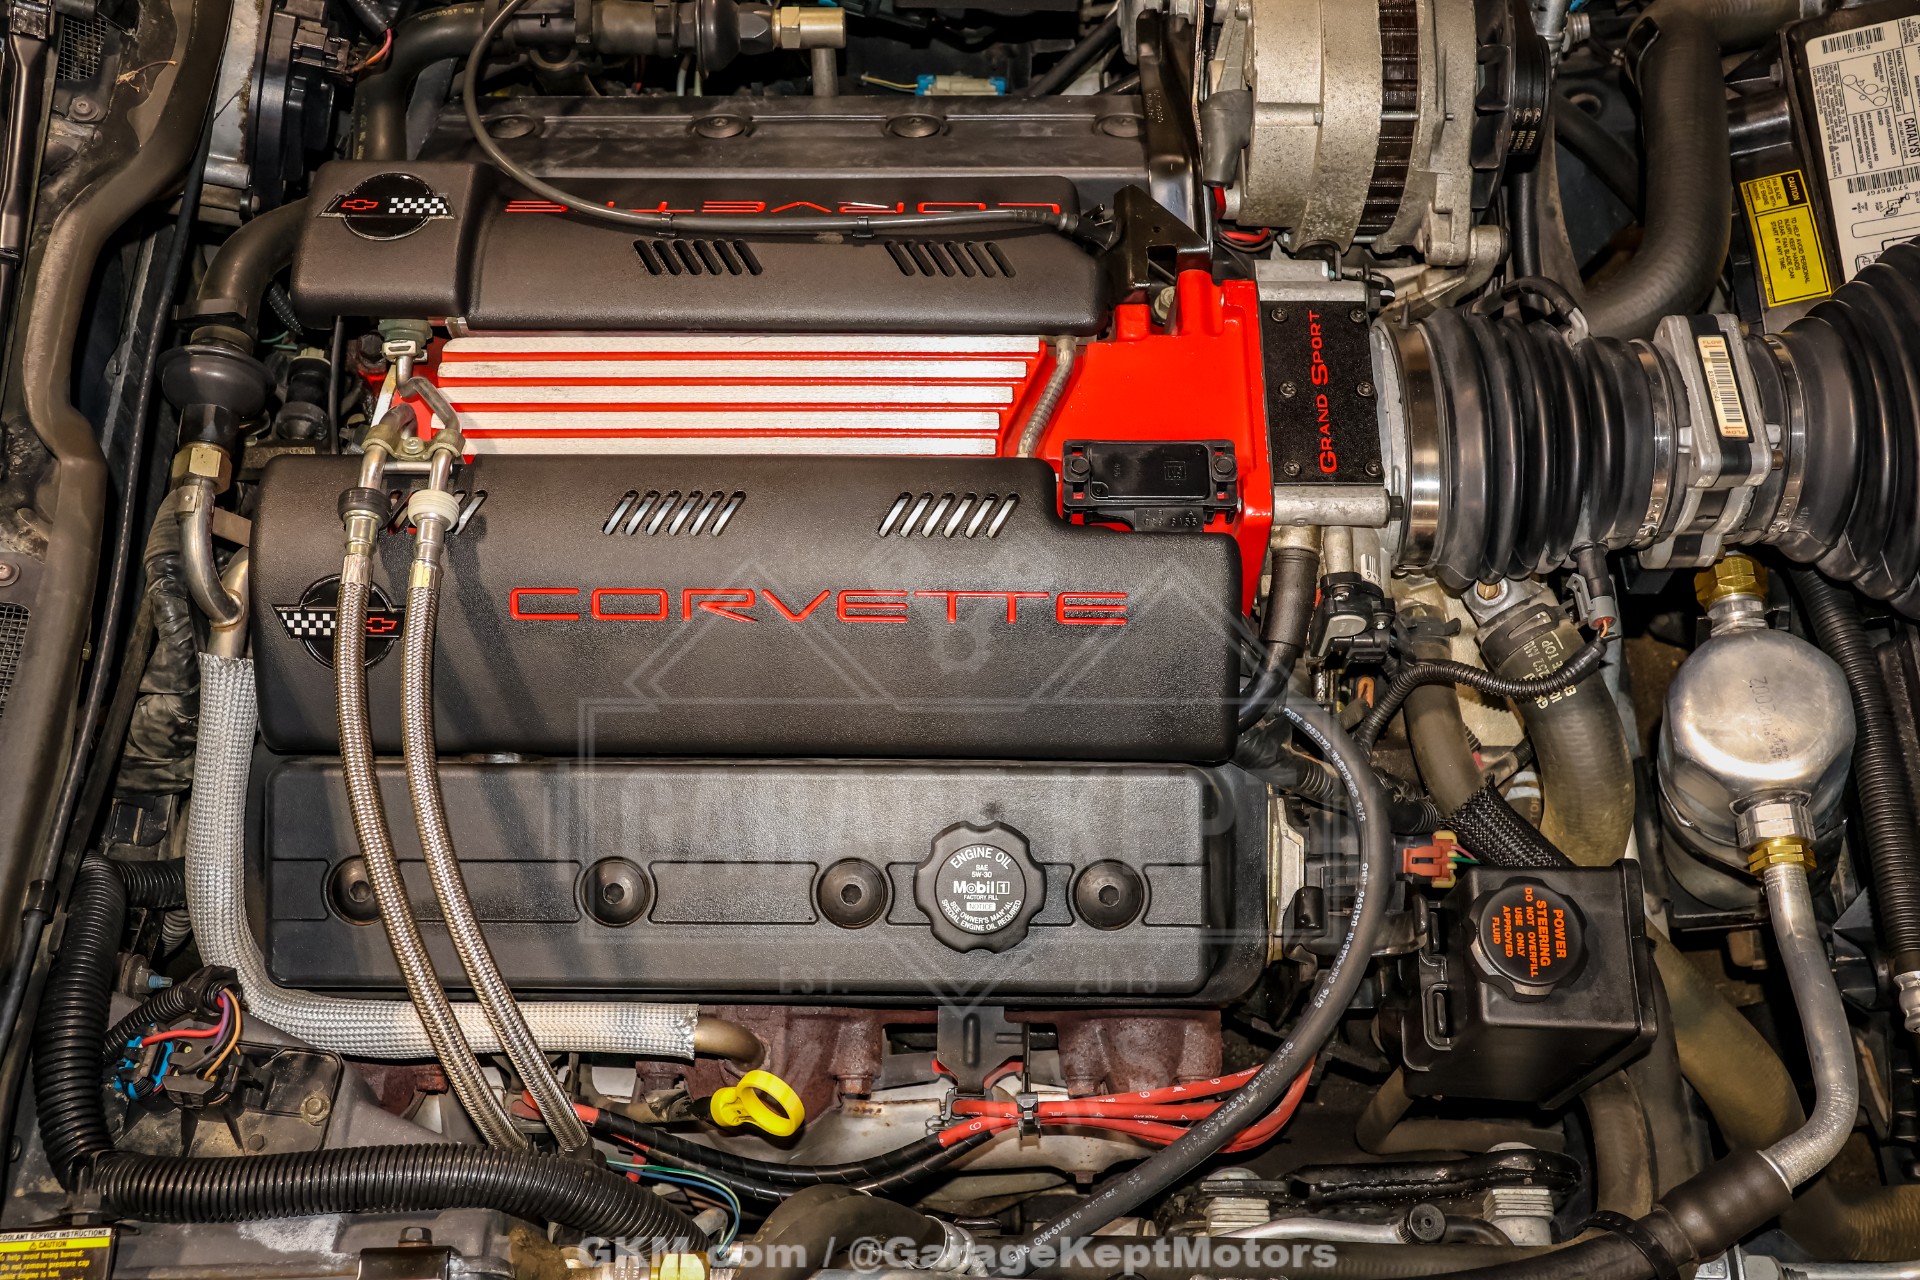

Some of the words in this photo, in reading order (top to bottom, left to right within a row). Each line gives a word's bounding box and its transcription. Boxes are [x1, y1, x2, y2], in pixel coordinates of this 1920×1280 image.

[1895, 49, 1903, 66] MANUAL
[1898, 66, 1908, 96] TRANSMISSION
[1852, 115, 1860, 137] ADDITIONAL
[1858, 113, 1867, 139] MAINTENANCE
[1863, 140, 1871, 160] SCHEDULE
[1887, 128, 1896, 155] ADJUSTMENTS
[1903, 117, 1920, 158] CATALYST
[1760, 189, 1769, 205] ENGINE
[1764, 179, 1773, 194] STARTS
[1773, 186, 1782, 200] BLADE
[1787, 175, 1799, 200] CAUTION
[1770, 220, 1778, 236] START
[1792, 224, 1800, 237] HELP
[1788, 237, 1796, 251] KEEP
[1795, 237, 1804, 254] AVOID
[1783, 248, 1792, 266] BLADE
[1791, 252, 1800, 270] HANDS
[1787, 266, 1795, 279] CAN
[1799, 255, 1811, 284] PERSONAL
[508, 587, 1128, 626] CORVETTE
[1540, 637, 1559, 661] TOP
[950, 847, 993, 869] ENGINE
[996, 852, 1013, 869] OIL
[953, 881, 994, 893] Mobil
[1525, 887, 1533, 902] DO
[942, 899, 959, 923] SPECIAL
[960, 921, 984, 931] ENGINE
[986, 922, 997, 930] OIL
[998, 900, 1021, 926] REQUIRED
[950, 901, 961, 914] SEE
[960, 912, 989, 923] OWNER'S
[1515, 907, 1523, 926] USE
[1526, 906, 1535, 926] NOT
[1492, 917, 1501, 944] FLUID
[1503, 905, 1513, 957] APPROVED
[1536, 900, 1551, 966] STEERING
[1553, 909, 1567, 958] POWER
[1315, 988, 1330, 1008] 5/16
[1350, 890, 1366, 926] 041596
[1516, 932, 1525, 957] ONLY
[1528, 932, 1538, 977] OVERFILL
[60, 1230, 106, 1238] INSTRUCTIONS
[1010, 1244, 1030, 1262] 5/16
[18, 1272, 39, 1280] engine
[48, 1261, 76, 1271] pressure
[78, 1260, 90, 1268] cap
